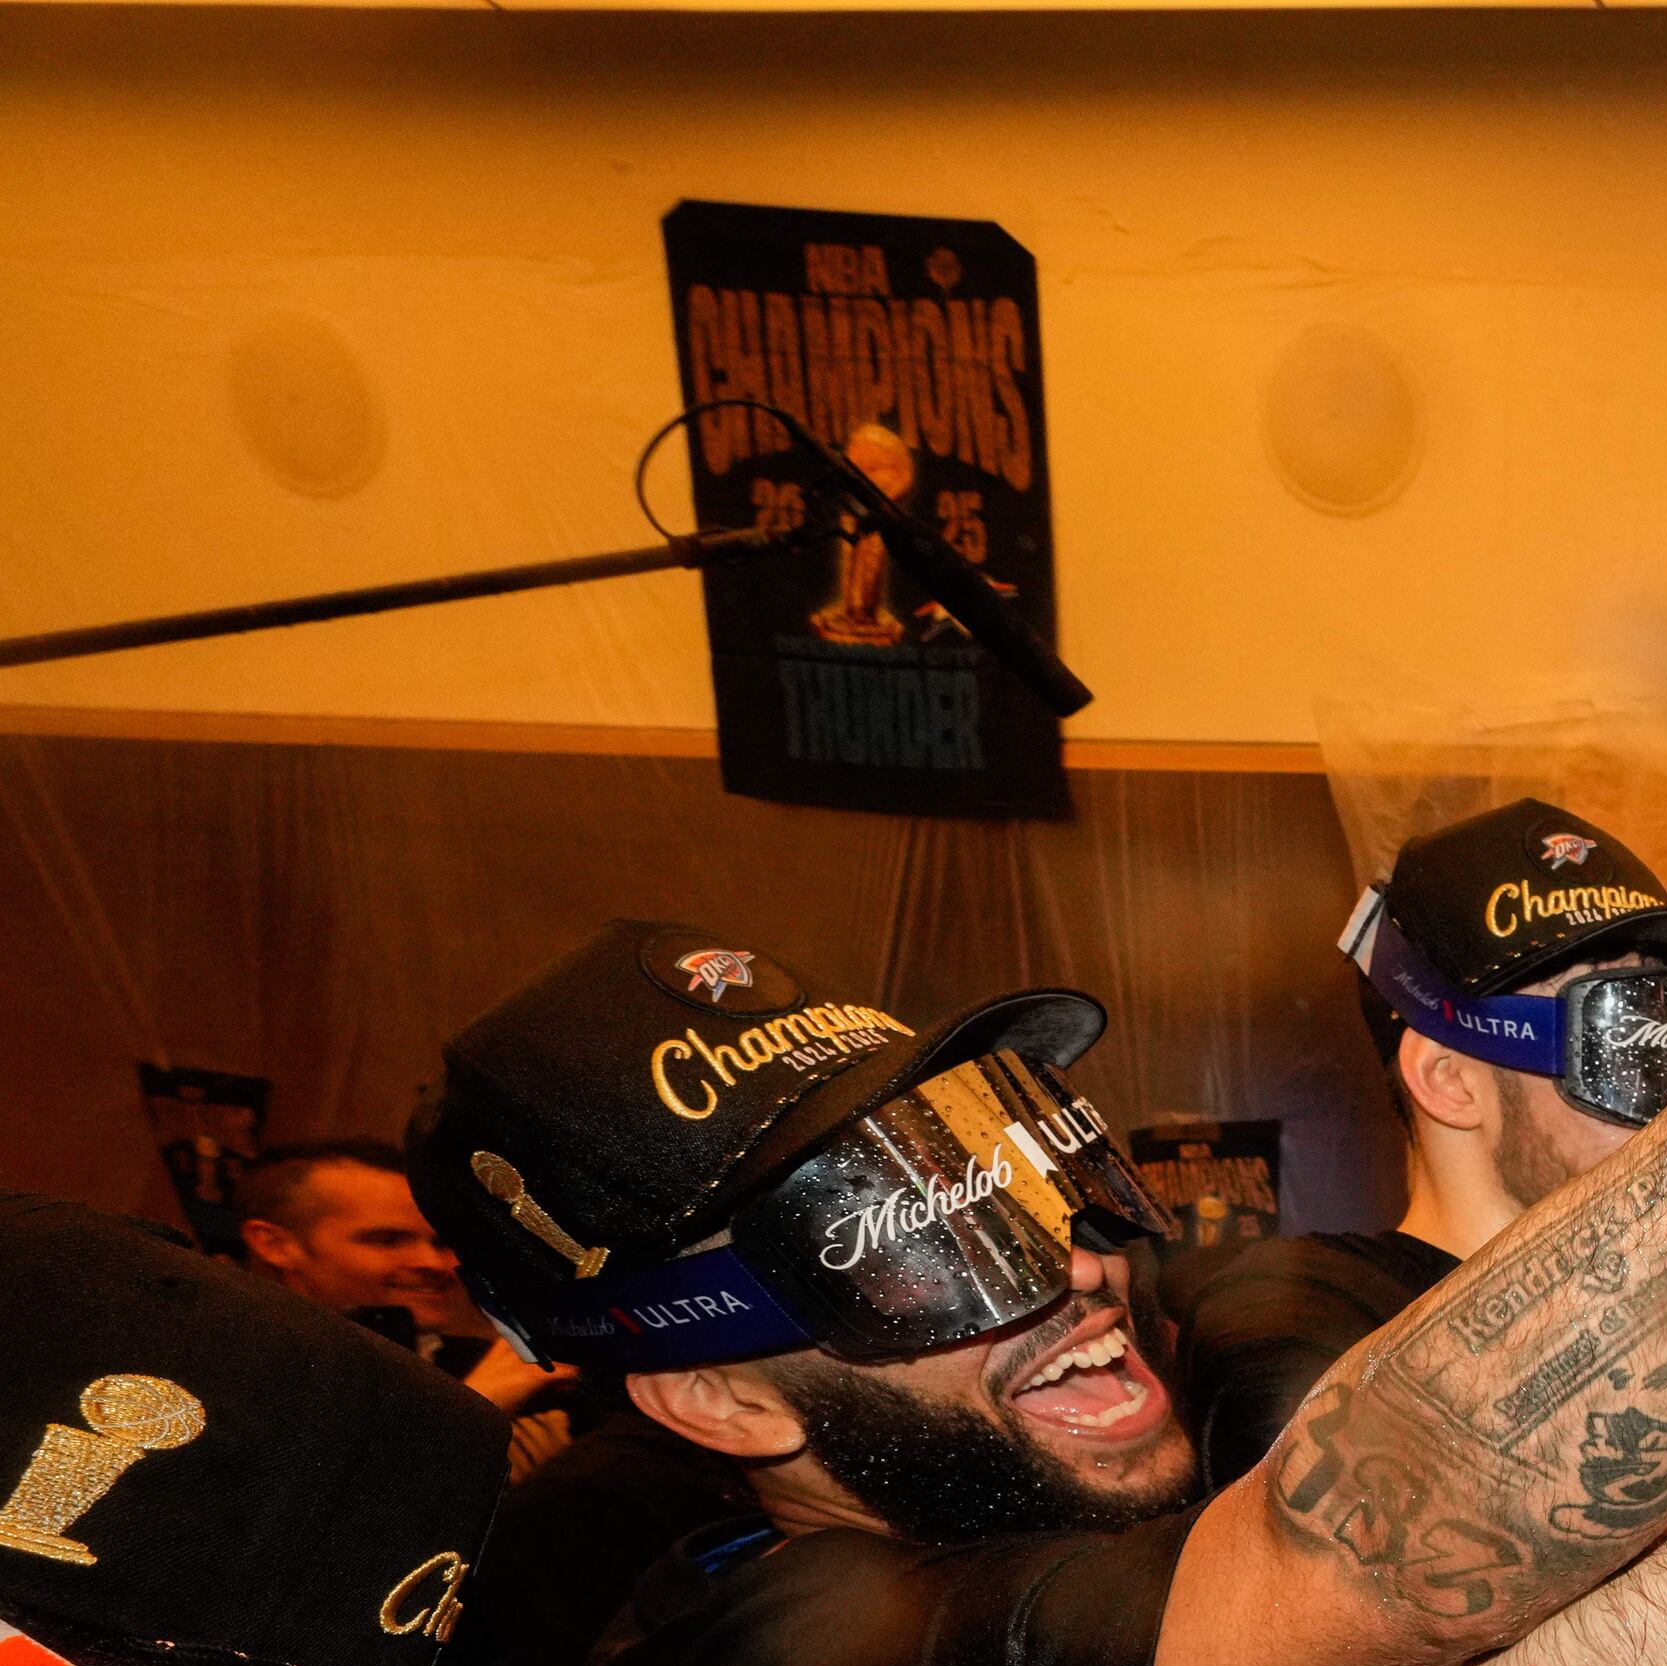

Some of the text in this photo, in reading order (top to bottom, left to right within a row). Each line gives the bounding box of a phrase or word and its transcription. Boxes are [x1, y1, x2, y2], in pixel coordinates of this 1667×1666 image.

[805, 243, 891, 295] NBA
[687, 283, 1033, 491] CHAMPIONS
[1485, 879, 1666, 938] Champion
[1456, 1009, 1536, 1041] ULTRA
[651, 1002, 917, 1120] Champion
[820, 1143, 1013, 1270] Michelob
[633, 1290, 753, 1329] ULTRA
